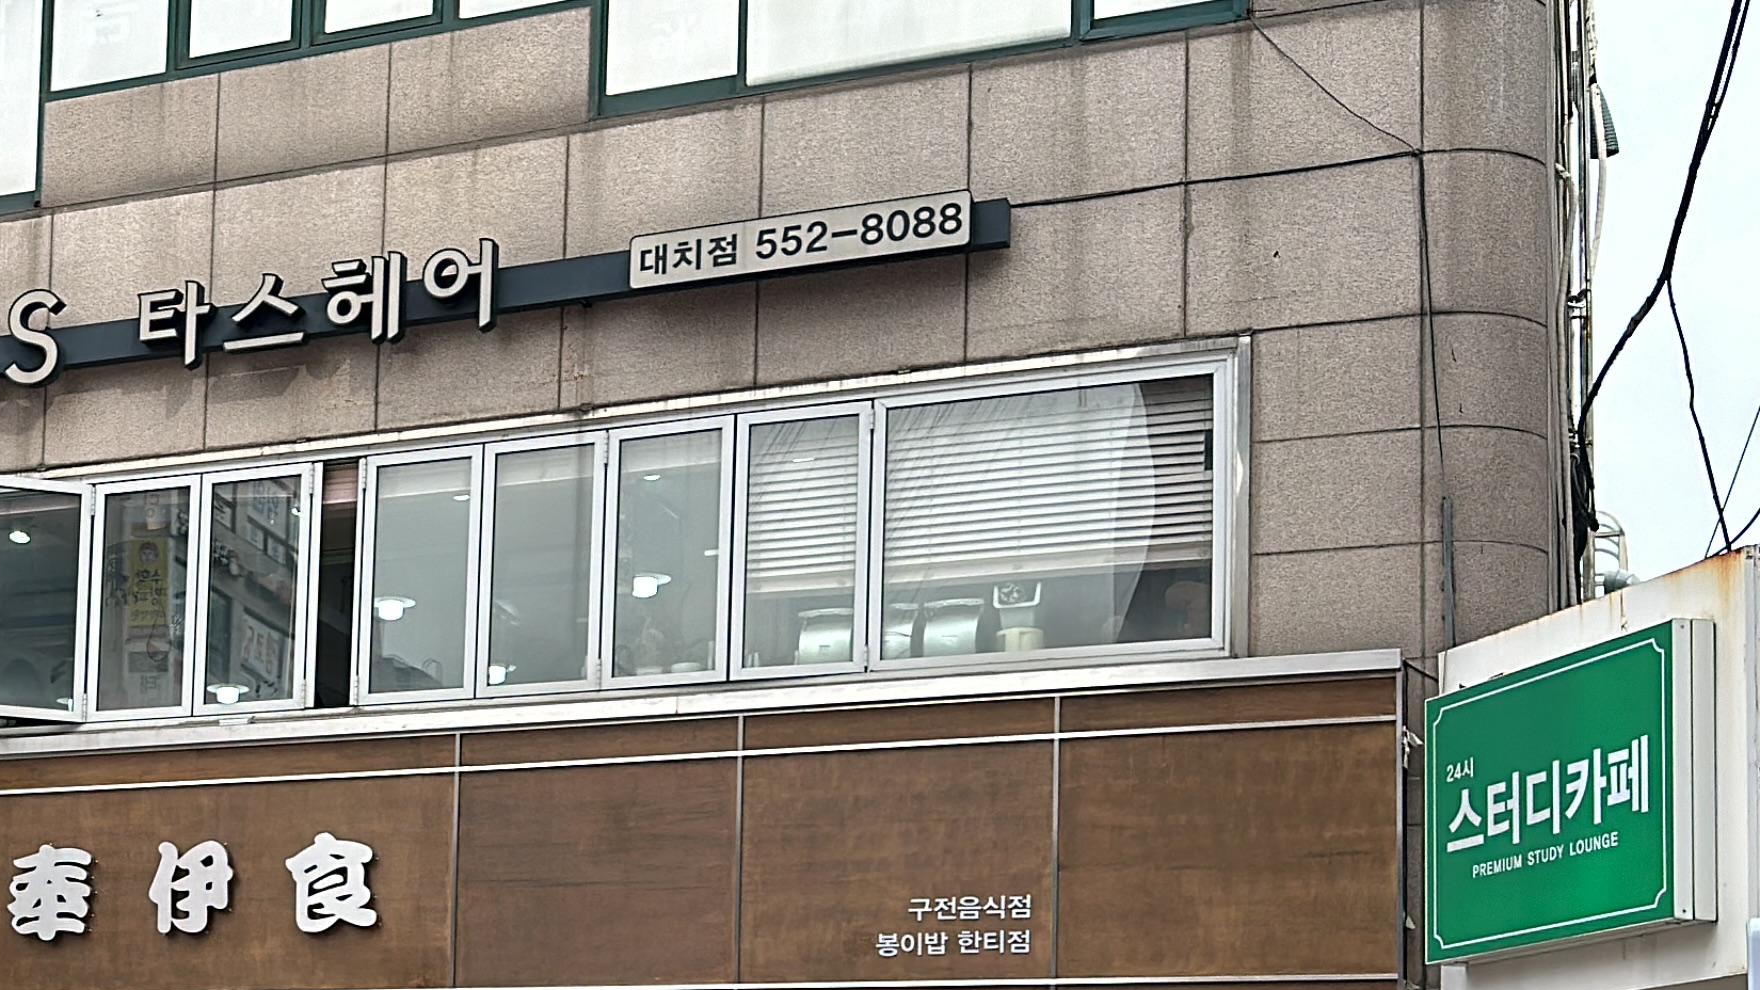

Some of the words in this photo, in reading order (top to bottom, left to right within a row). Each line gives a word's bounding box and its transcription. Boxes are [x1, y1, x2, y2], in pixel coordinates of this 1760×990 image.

[639, 233, 740, 278] 대치점
[754, 201, 965, 261] 552-8088
[137, 238, 498, 371] 타스헤어
[1446, 756, 1475, 783] 24시
[1446, 733, 1650, 854] 스터디카페
[1472, 853, 1523, 879] PREMIUM
[1526, 843, 1565, 868] STUDY
[1568, 830, 1620, 857] LOUNGE
[907, 893, 1033, 922] 구전음식점
[875, 930, 949, 958] 봉이밥
[956, 928, 1032, 955] 한티점
